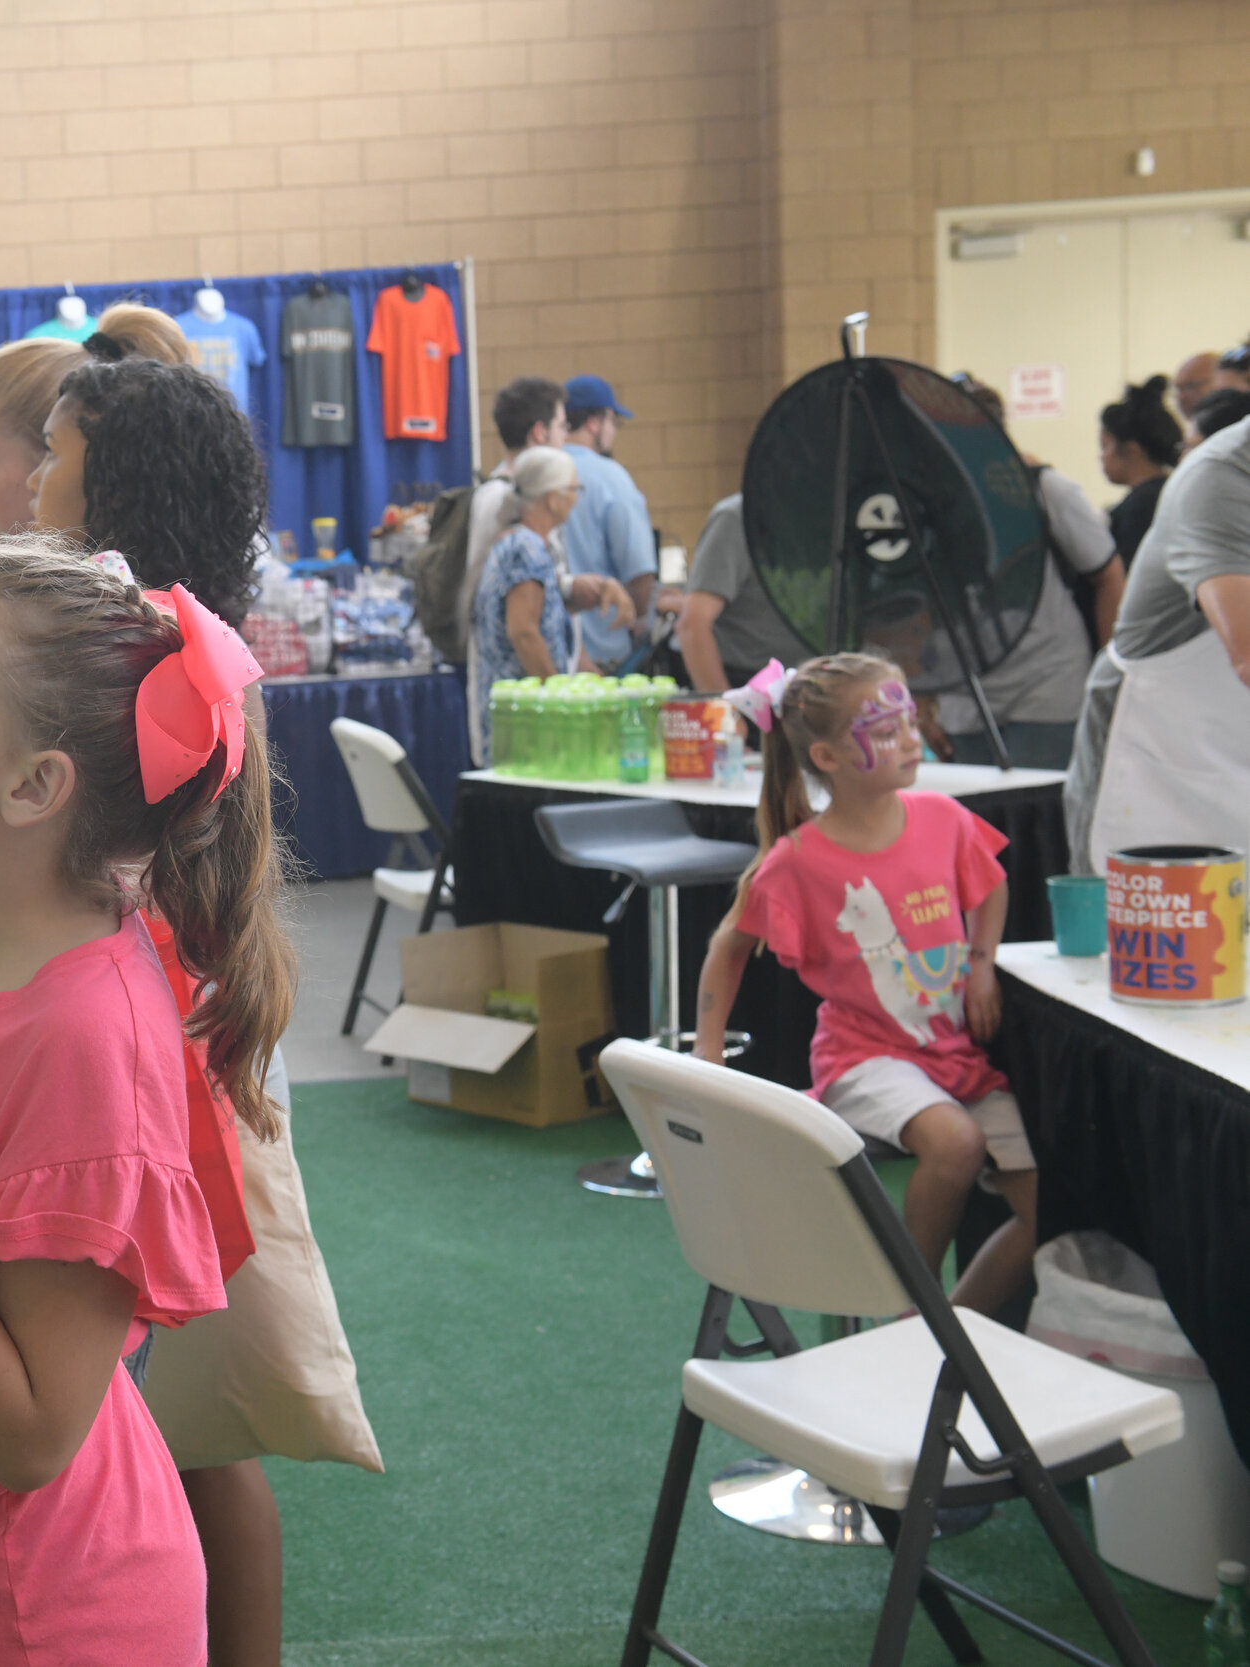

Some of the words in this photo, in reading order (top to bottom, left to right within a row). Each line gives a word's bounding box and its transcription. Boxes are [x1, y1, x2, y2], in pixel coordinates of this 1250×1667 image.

[1129, 893, 1191, 909] OWN
[1112, 927, 1185, 958] WIN
[1110, 958, 1197, 990] IZES
